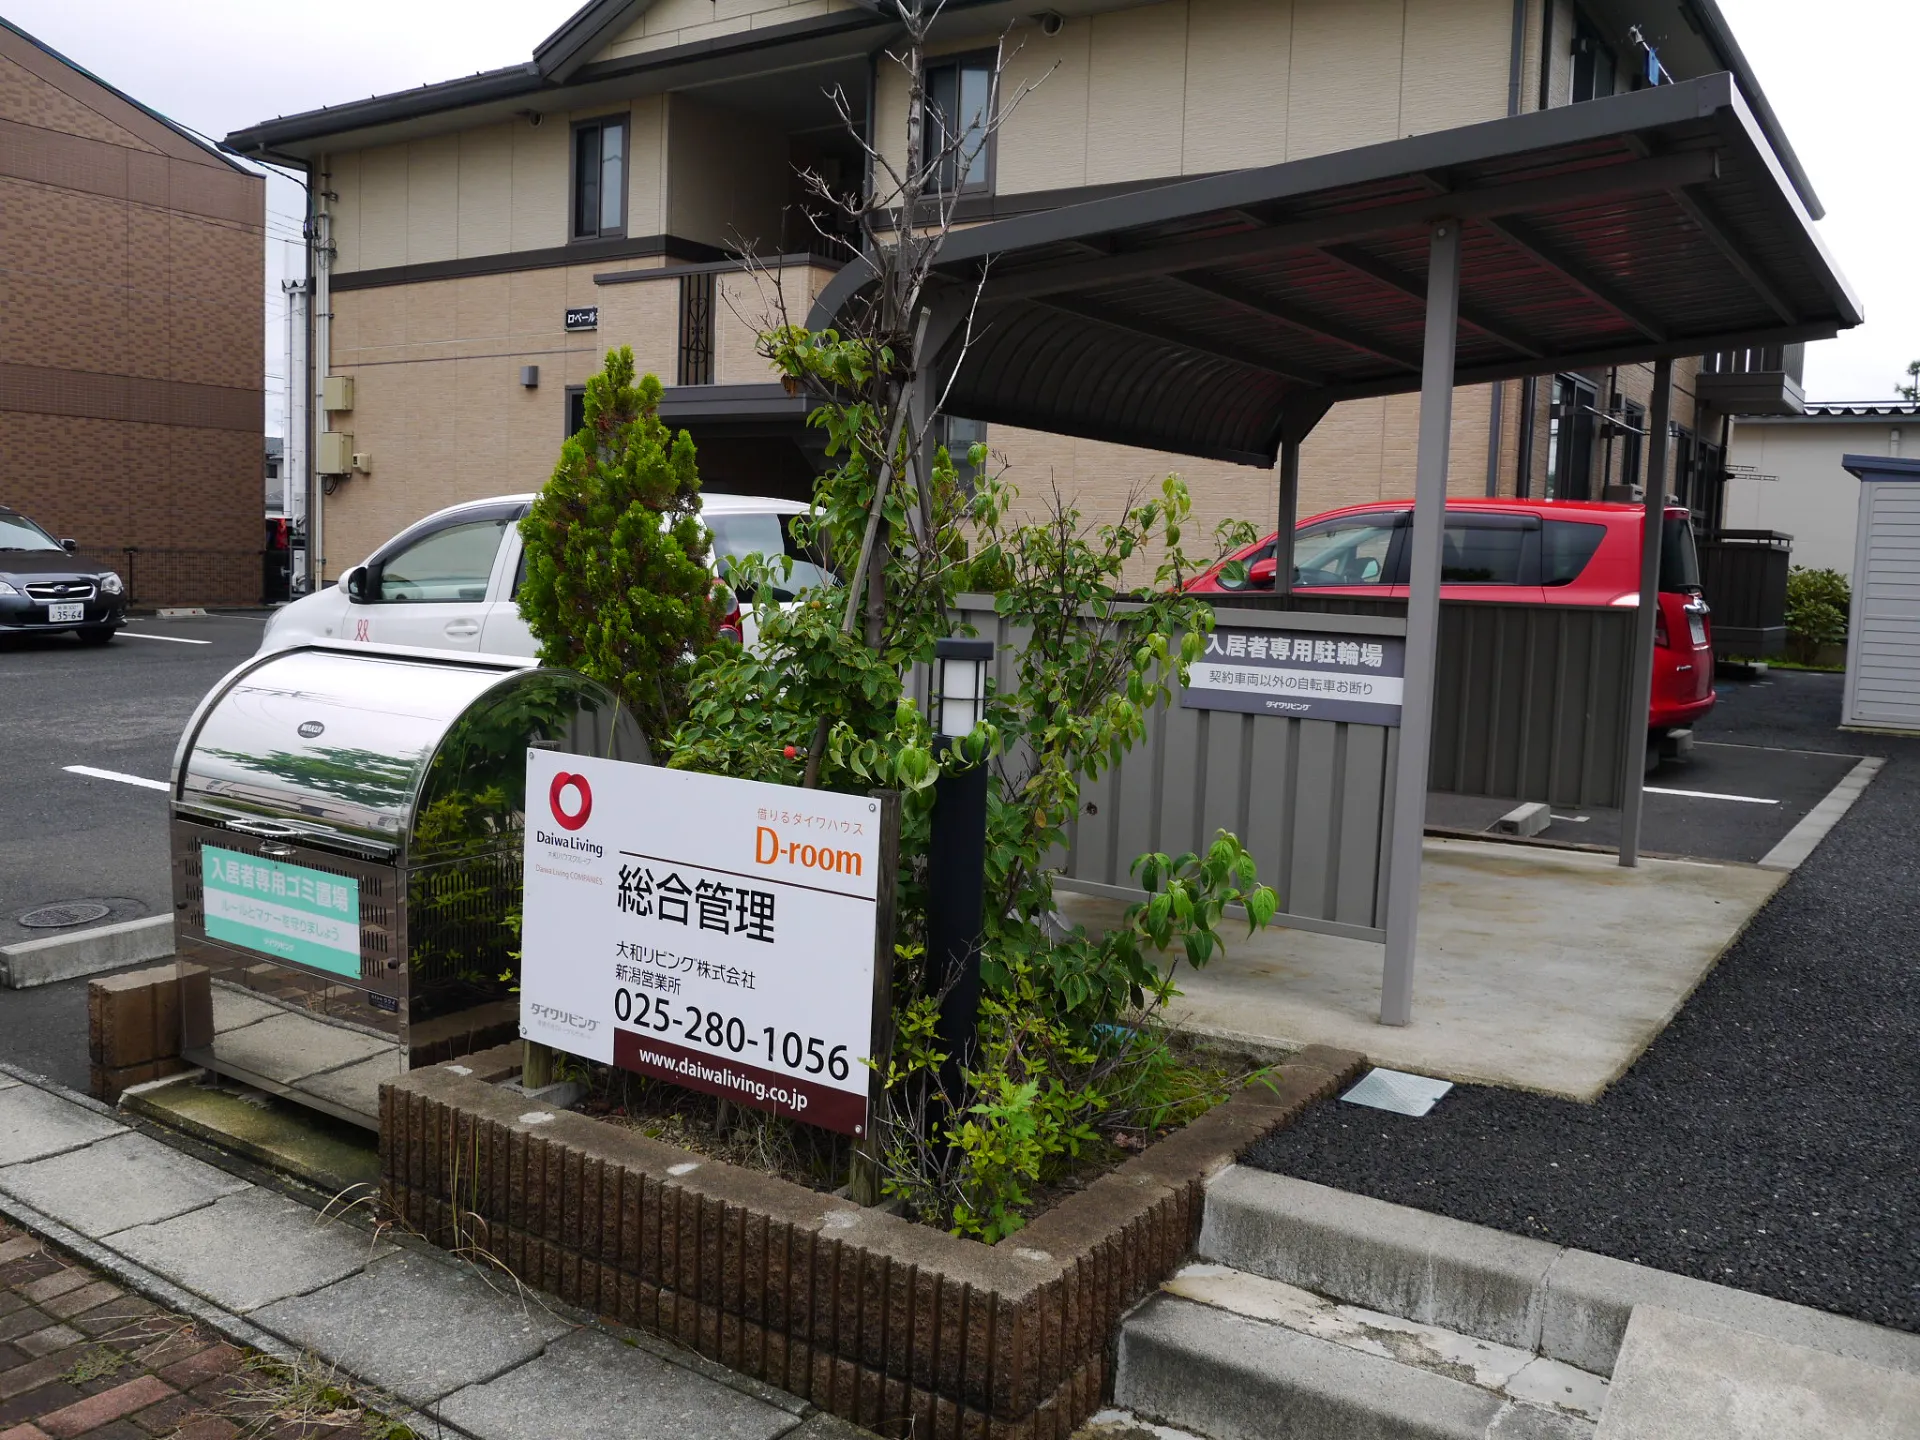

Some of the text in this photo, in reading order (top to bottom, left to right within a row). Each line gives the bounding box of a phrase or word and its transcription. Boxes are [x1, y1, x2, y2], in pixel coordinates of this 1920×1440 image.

[1205, 633, 1384, 668] 入居者専用駐輪場
[1209, 669, 1374, 696] 契約車両以外の自転車お断り
[1265, 700, 1312, 711] ダイワリビング
[757, 807, 864, 836] 借りるダイワハウス
[755, 826, 862, 876] D-room
[211, 856, 349, 913] 入居者専用ゴミ置場
[617, 863, 775, 944] 総合管理
[221, 899, 340, 942] ルールとマナーを守りましょう
[615, 963, 681, 996] 新潟営業所
[616, 940, 756, 990] 大和リビング株式会社
[531, 1002, 601, 1032] ダイワリビング
[614, 987, 849, 1081] 025-280-1056
[639, 1048, 808, 1111] www.daiwaliving.co.jp
